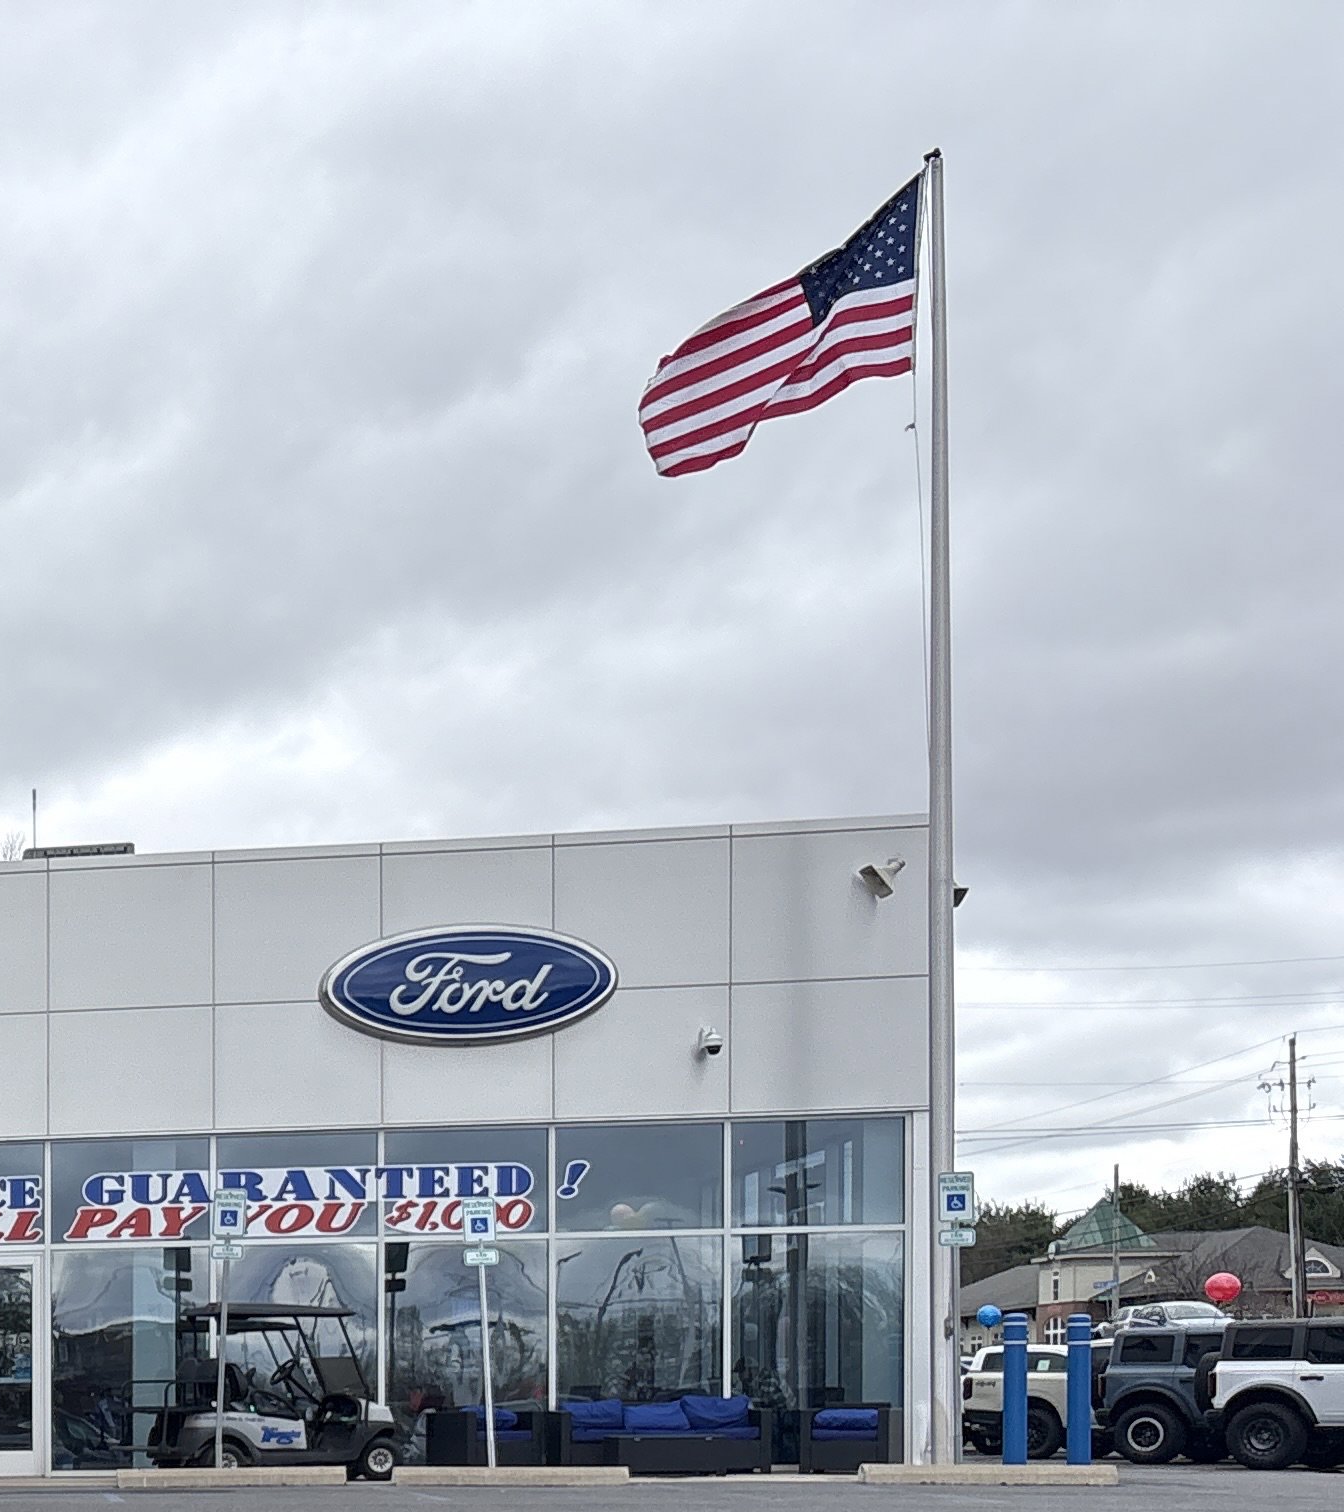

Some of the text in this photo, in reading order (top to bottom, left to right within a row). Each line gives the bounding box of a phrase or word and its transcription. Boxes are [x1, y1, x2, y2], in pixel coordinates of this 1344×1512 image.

[389, 951, 553, 1015] Ford
[85, 1165, 532, 1204] GUARANTEED
[67, 1205, 207, 1239] PAY
